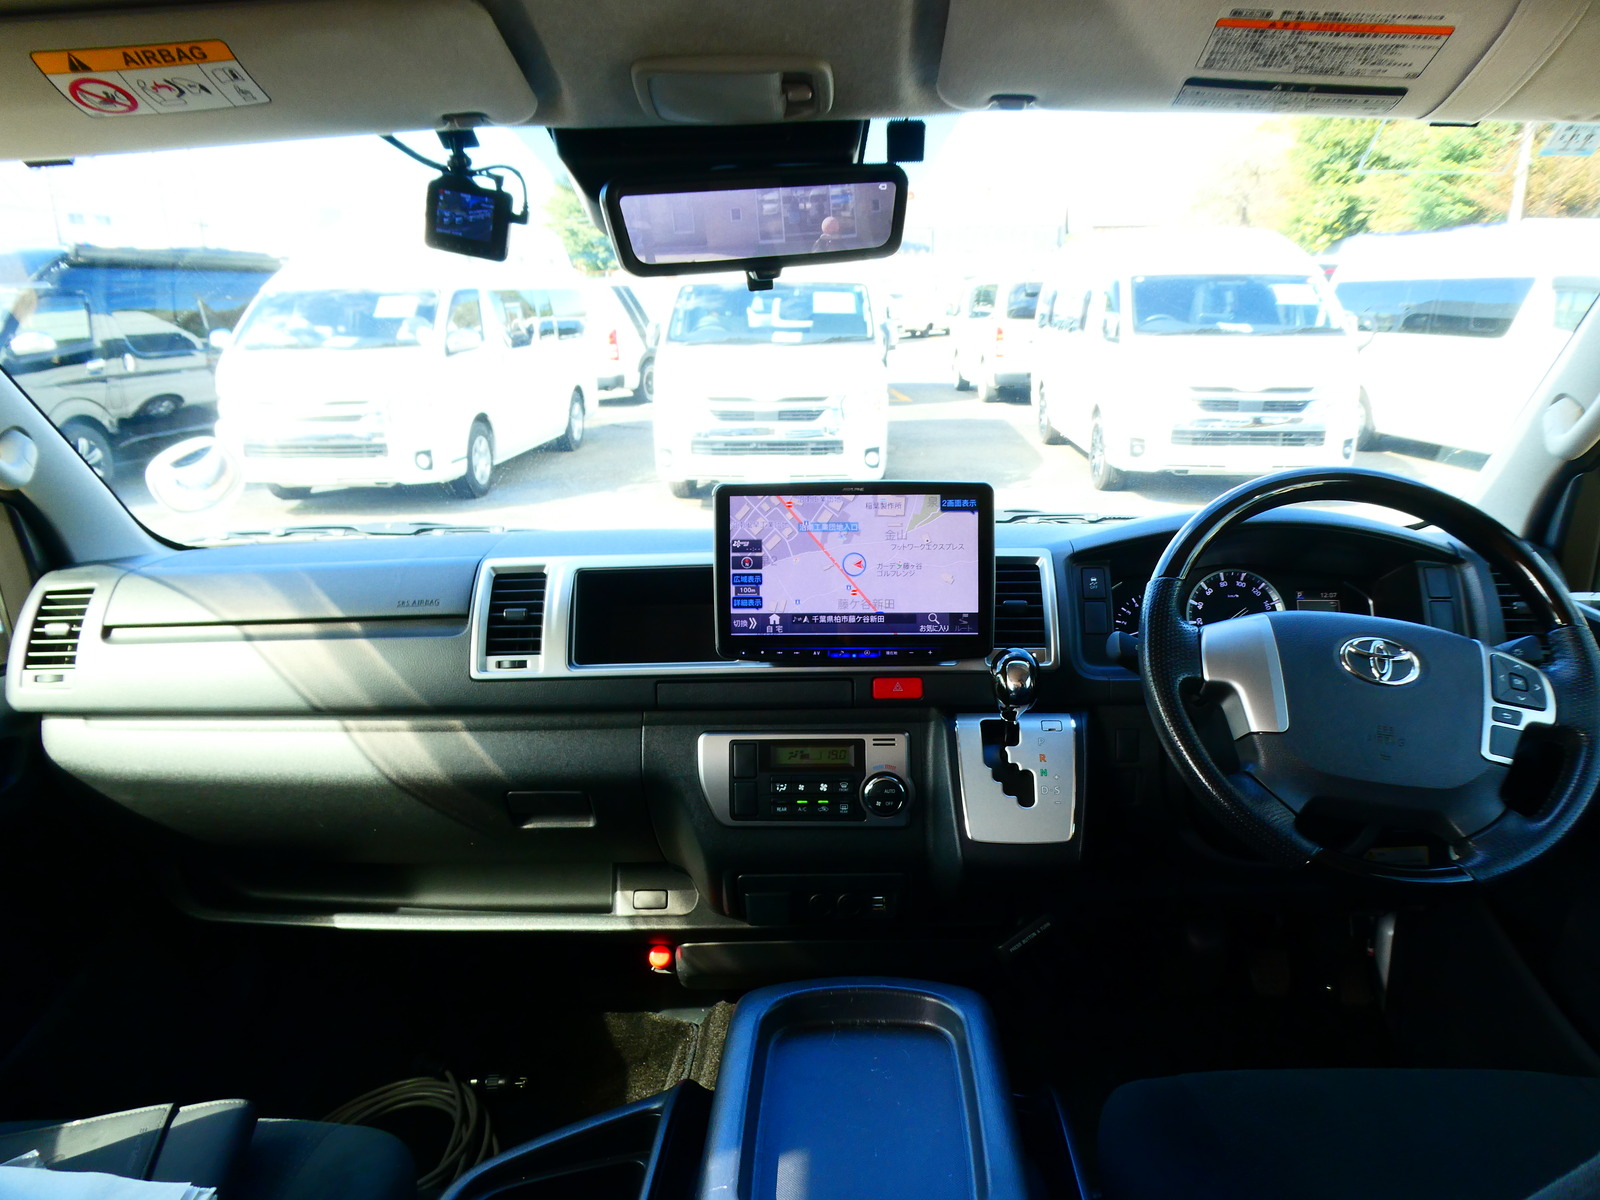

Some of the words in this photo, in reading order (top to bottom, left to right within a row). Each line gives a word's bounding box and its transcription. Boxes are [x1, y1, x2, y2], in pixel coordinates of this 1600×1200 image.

[122, 46, 209, 67] AIRBAG
[941, 499, 977, 508] 2画面表示
[885, 529, 908, 541] 金山
[1235, 580, 1247, 588] 100
[1251, 587, 1262, 597] 120
[1263, 599, 1272, 611] 140
[919, 624, 950, 632] お気に入り
[1037, 737, 1046, 746] P
[1039, 754, 1047, 763] R
[1039, 769, 1048, 777] N
